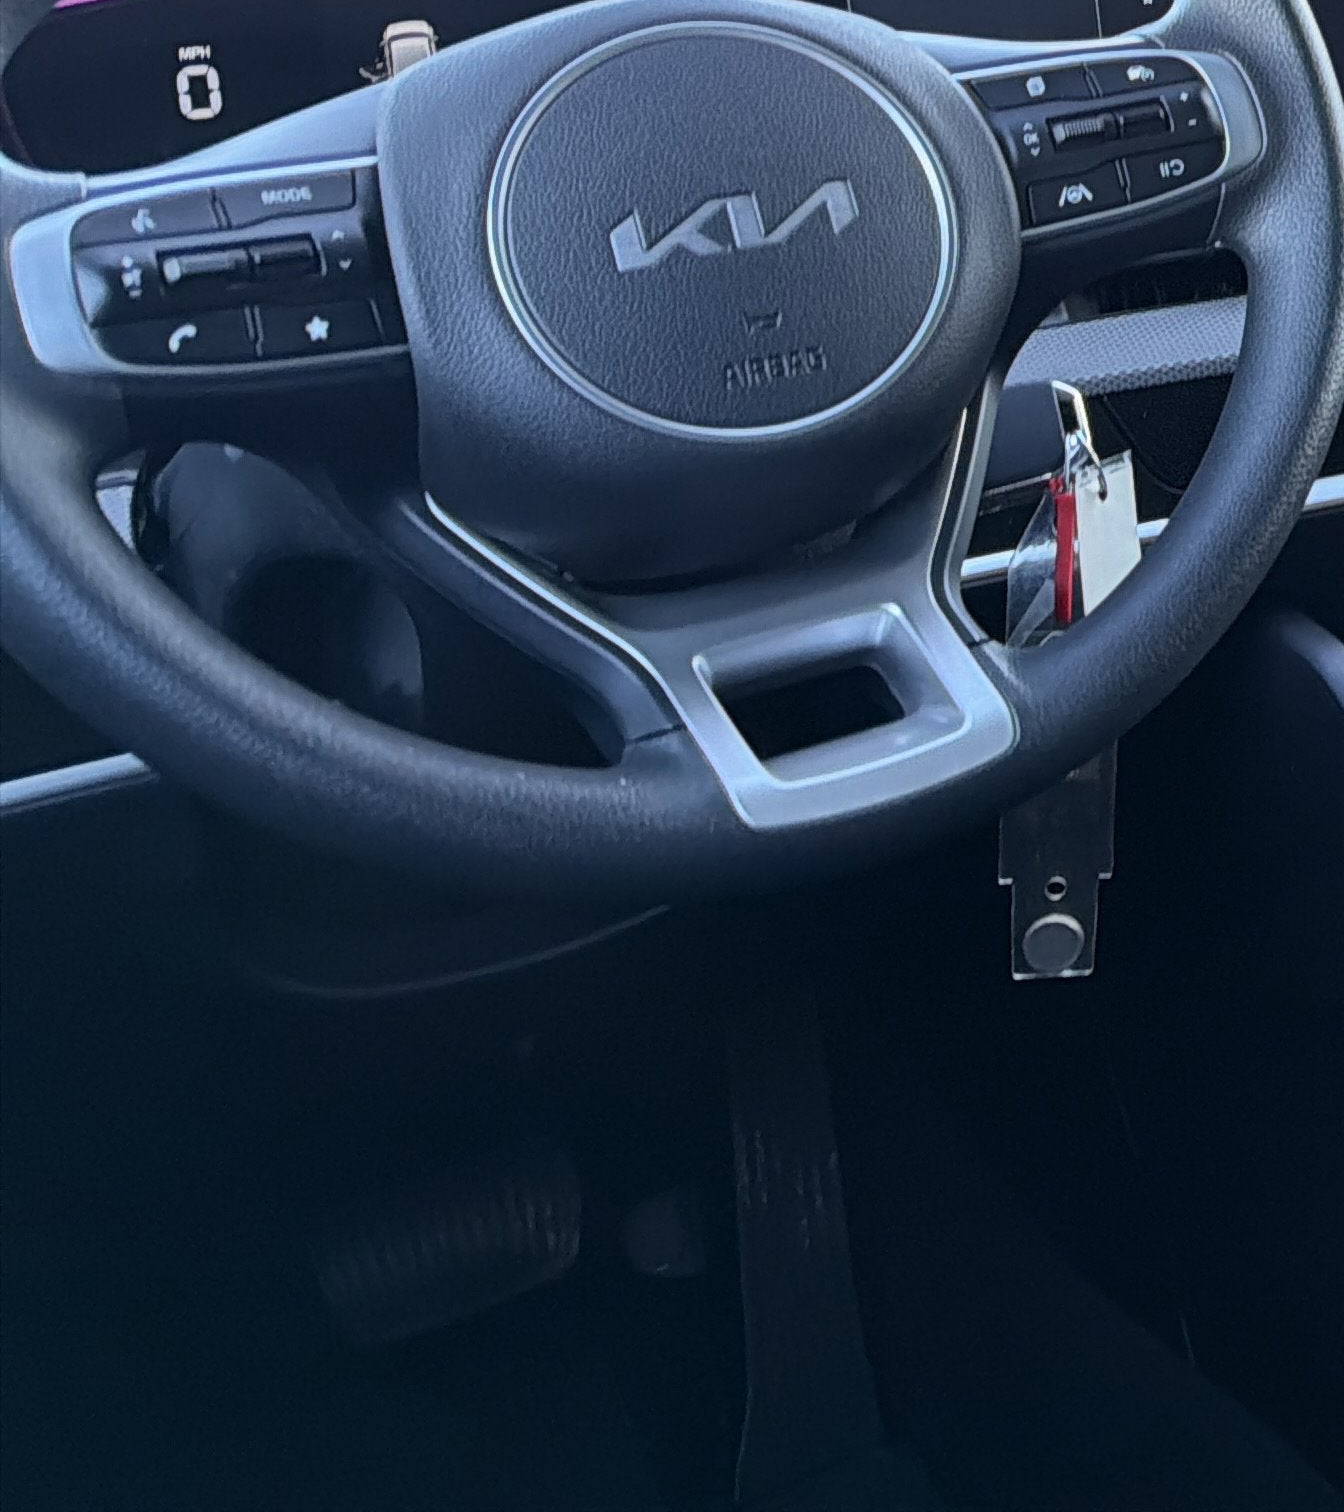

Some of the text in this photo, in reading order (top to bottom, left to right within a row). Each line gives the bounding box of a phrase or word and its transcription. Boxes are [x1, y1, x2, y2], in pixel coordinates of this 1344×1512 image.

[178, 45, 211, 62] MPH
[176, 64, 223, 121] 0
[260, 186, 313, 206] MODE
[609, 178, 860, 274] KIA
[725, 344, 828, 391] AIRBAG
